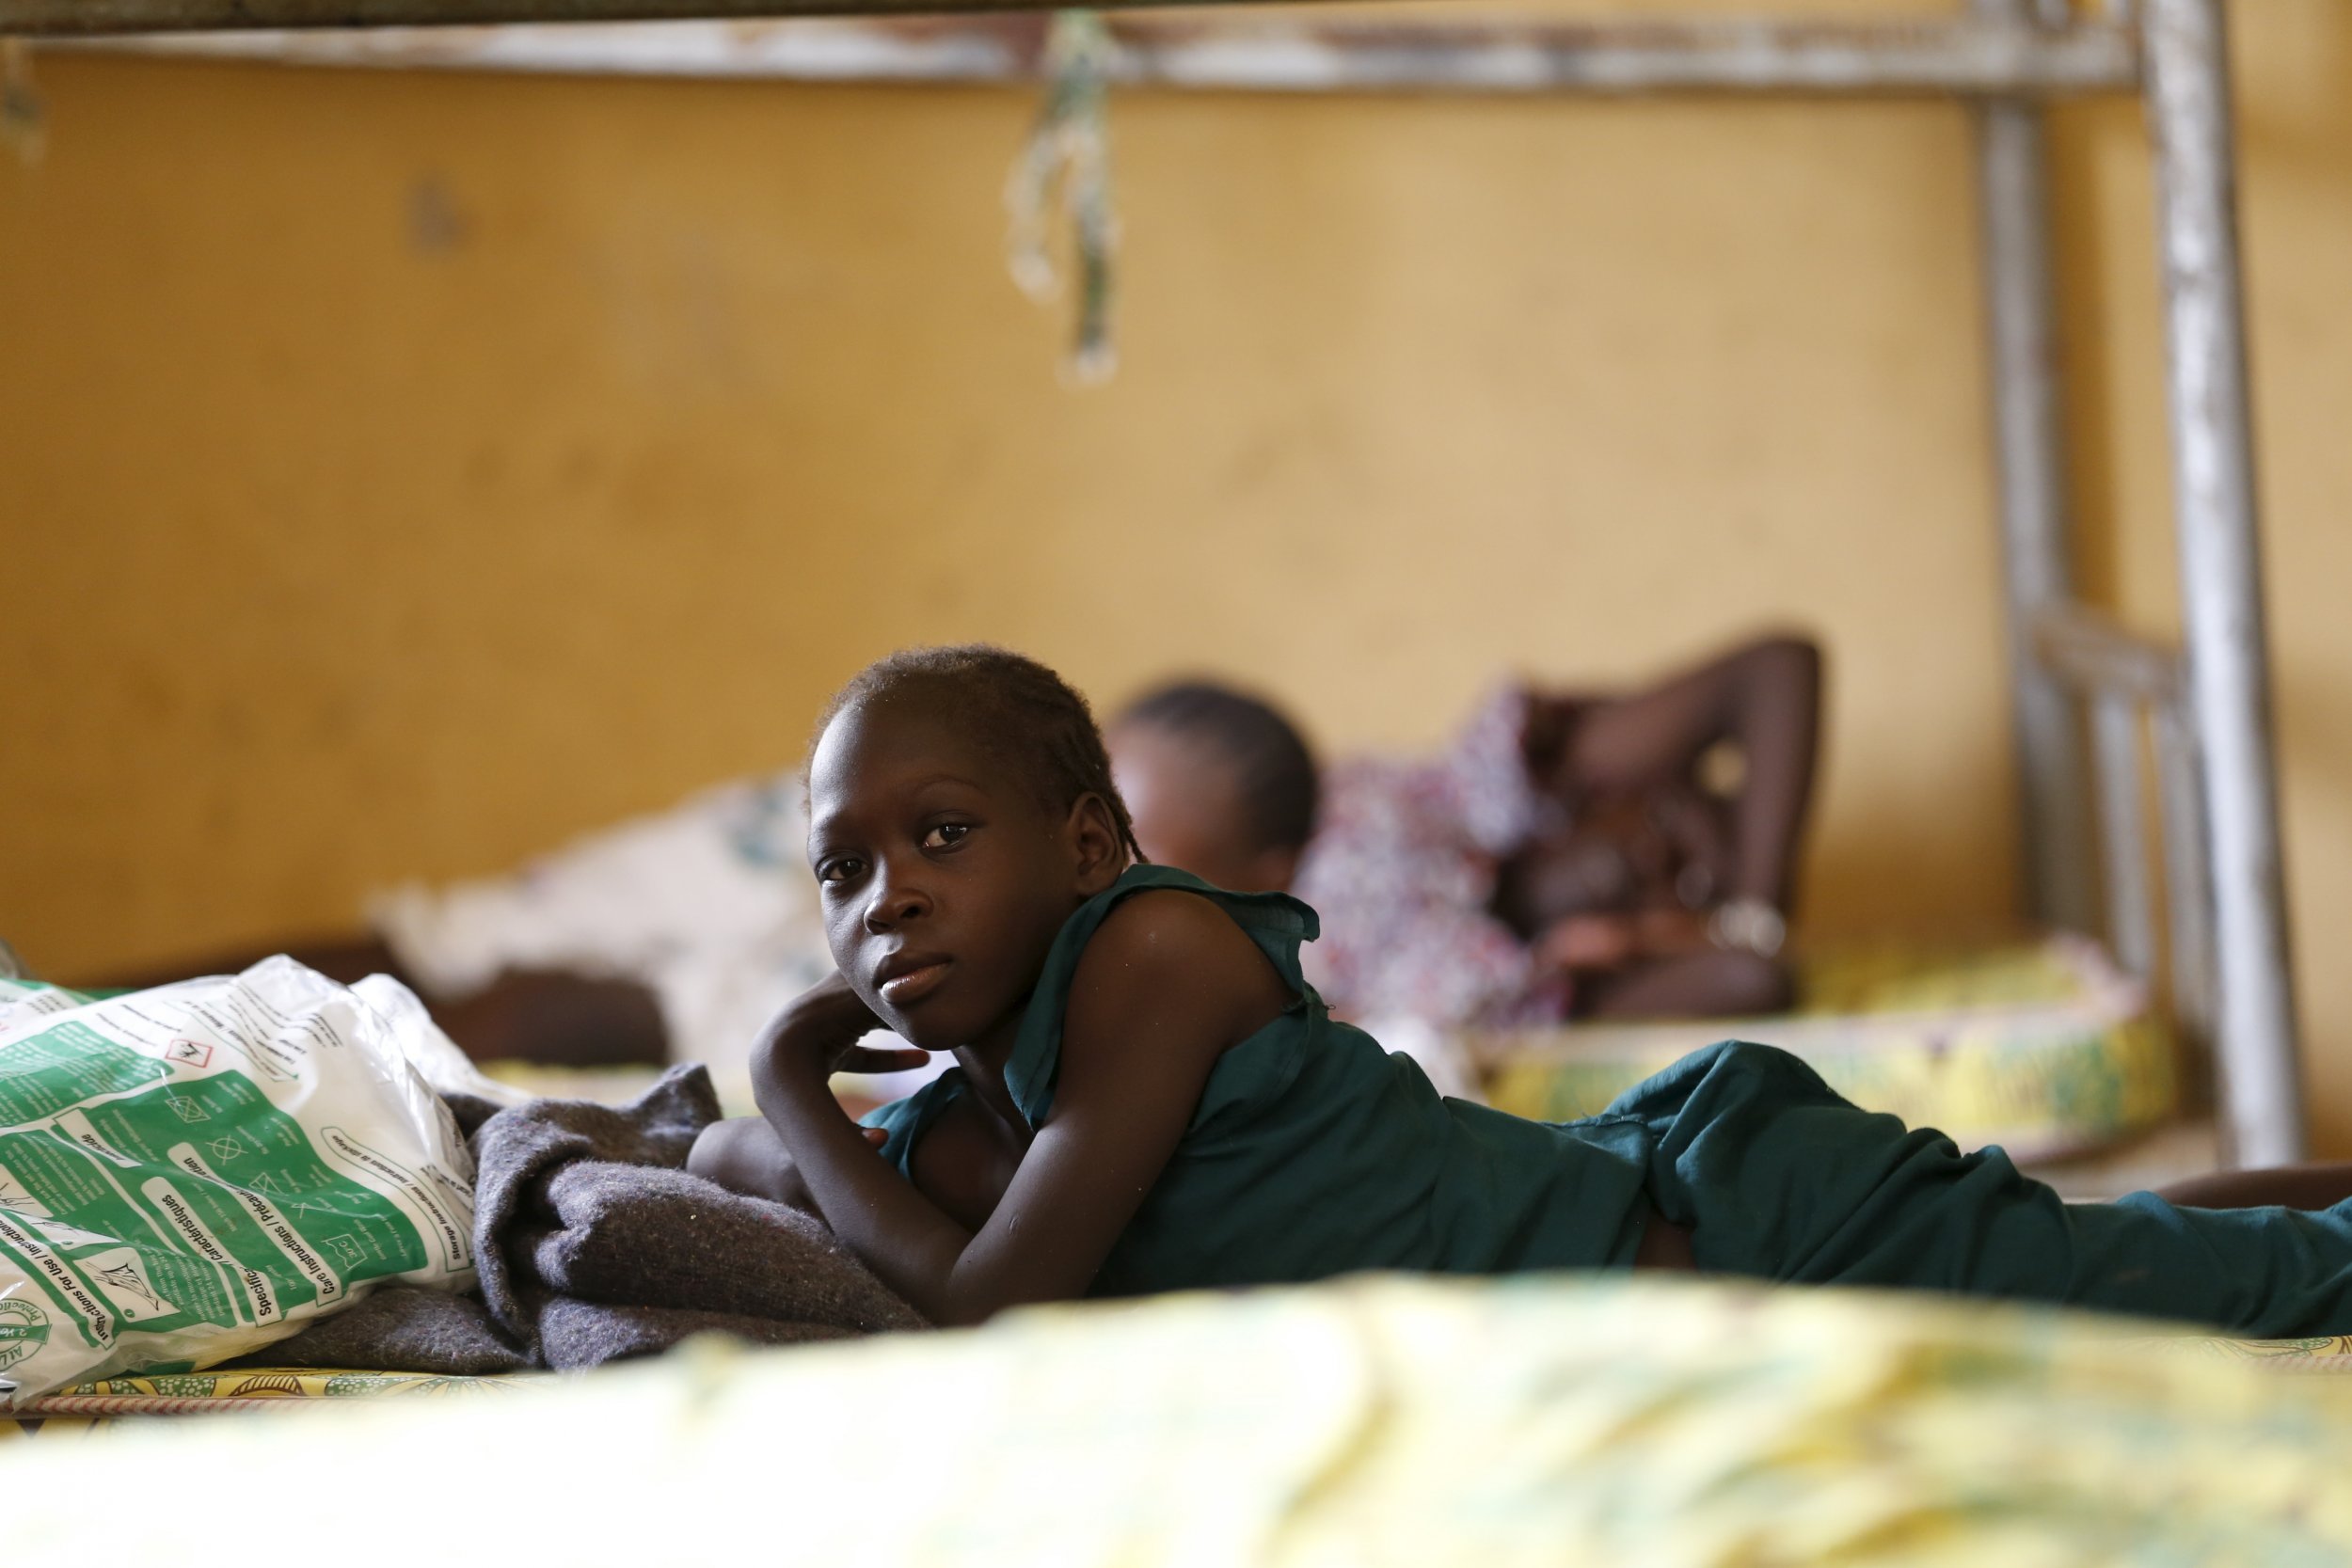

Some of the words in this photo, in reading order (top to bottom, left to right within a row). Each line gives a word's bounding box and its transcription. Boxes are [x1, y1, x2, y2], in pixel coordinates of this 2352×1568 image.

[371, 1160, 409, 1184] Instructions
[411, 1186, 448, 1225] Instructions
[162, 1194, 223, 1260] Caractéristiques
[444, 1226, 461, 1260] Storage
[43, 1259, 62, 1276] Use
[275, 1226, 321, 1275] Instructions
[58, 1276, 76, 1291] For
[316, 1272, 335, 1294] Care
[72, 1291, 109, 1340] Instructions
